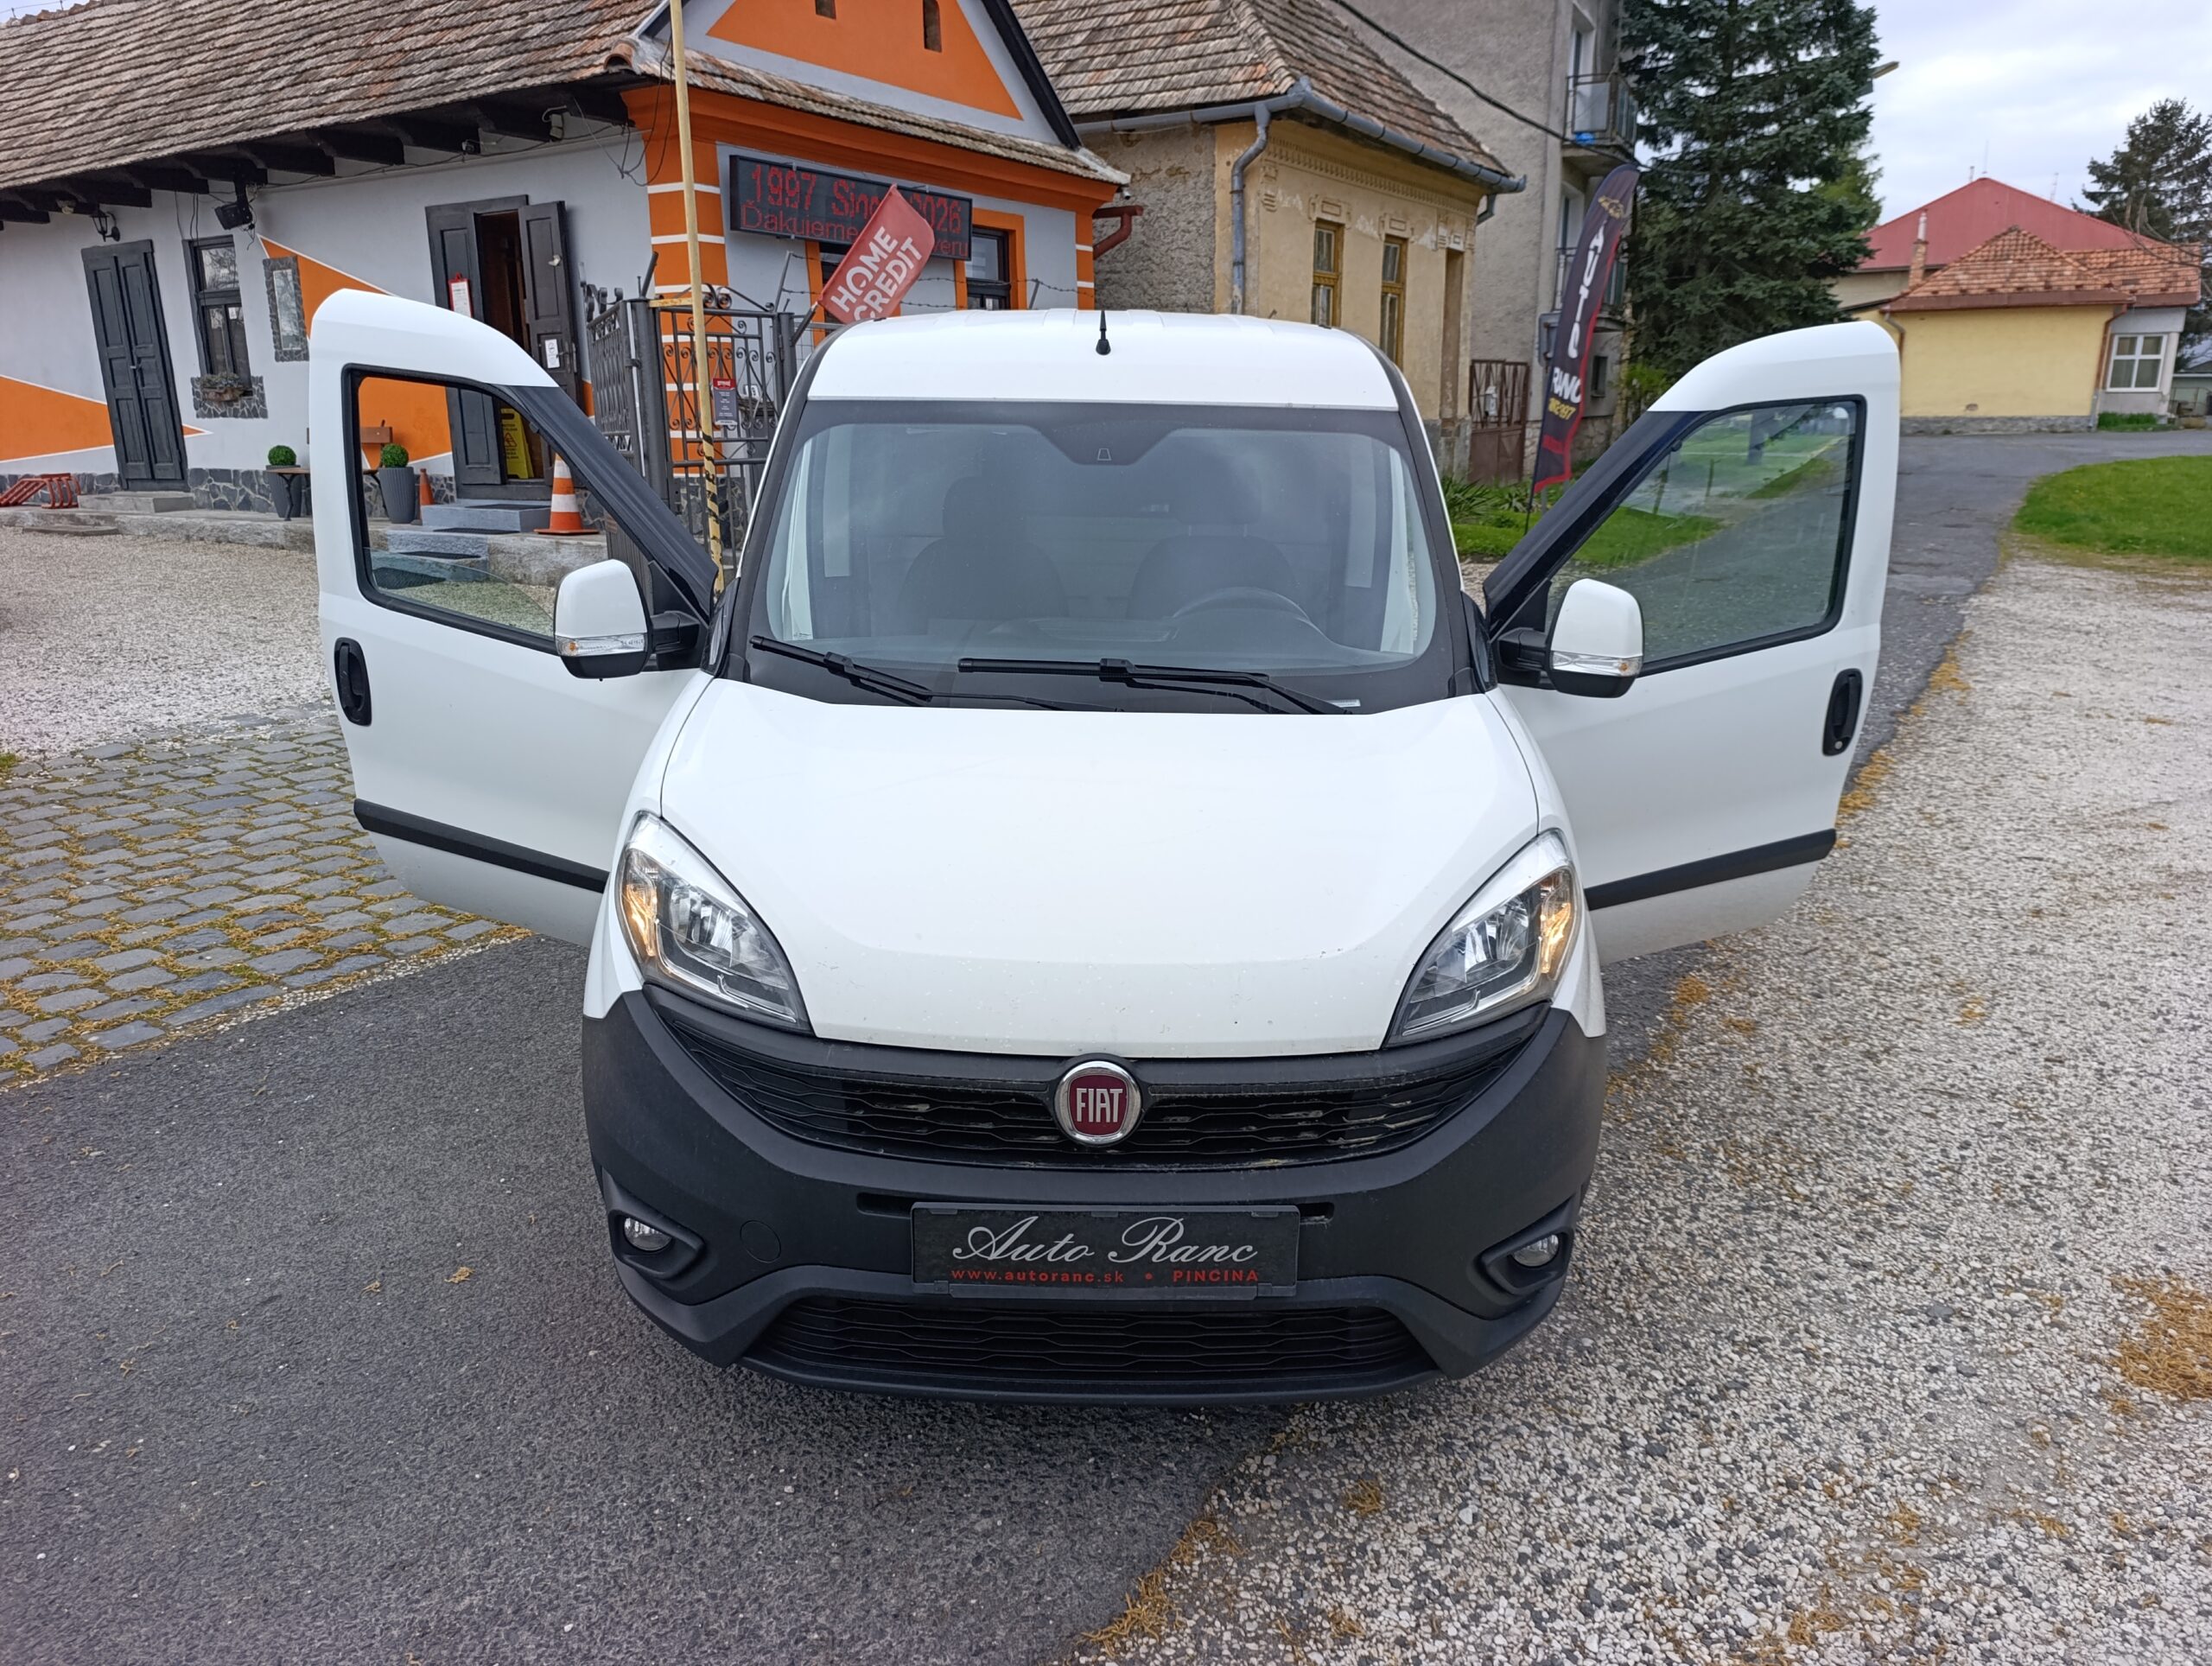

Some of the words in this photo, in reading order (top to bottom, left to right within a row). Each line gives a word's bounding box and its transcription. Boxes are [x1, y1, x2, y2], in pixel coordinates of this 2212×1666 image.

[752, 164, 817, 210] 1997
[830, 226, 899, 312] HOME
[854, 236, 922, 321] CREDIT
[1076, 1087, 1123, 1123] FIAT
[952, 1216, 1095, 1262] Auto
[1107, 1216, 1258, 1263] Ranc
[951, 1269, 1124, 1283] www.autoranc.sk
